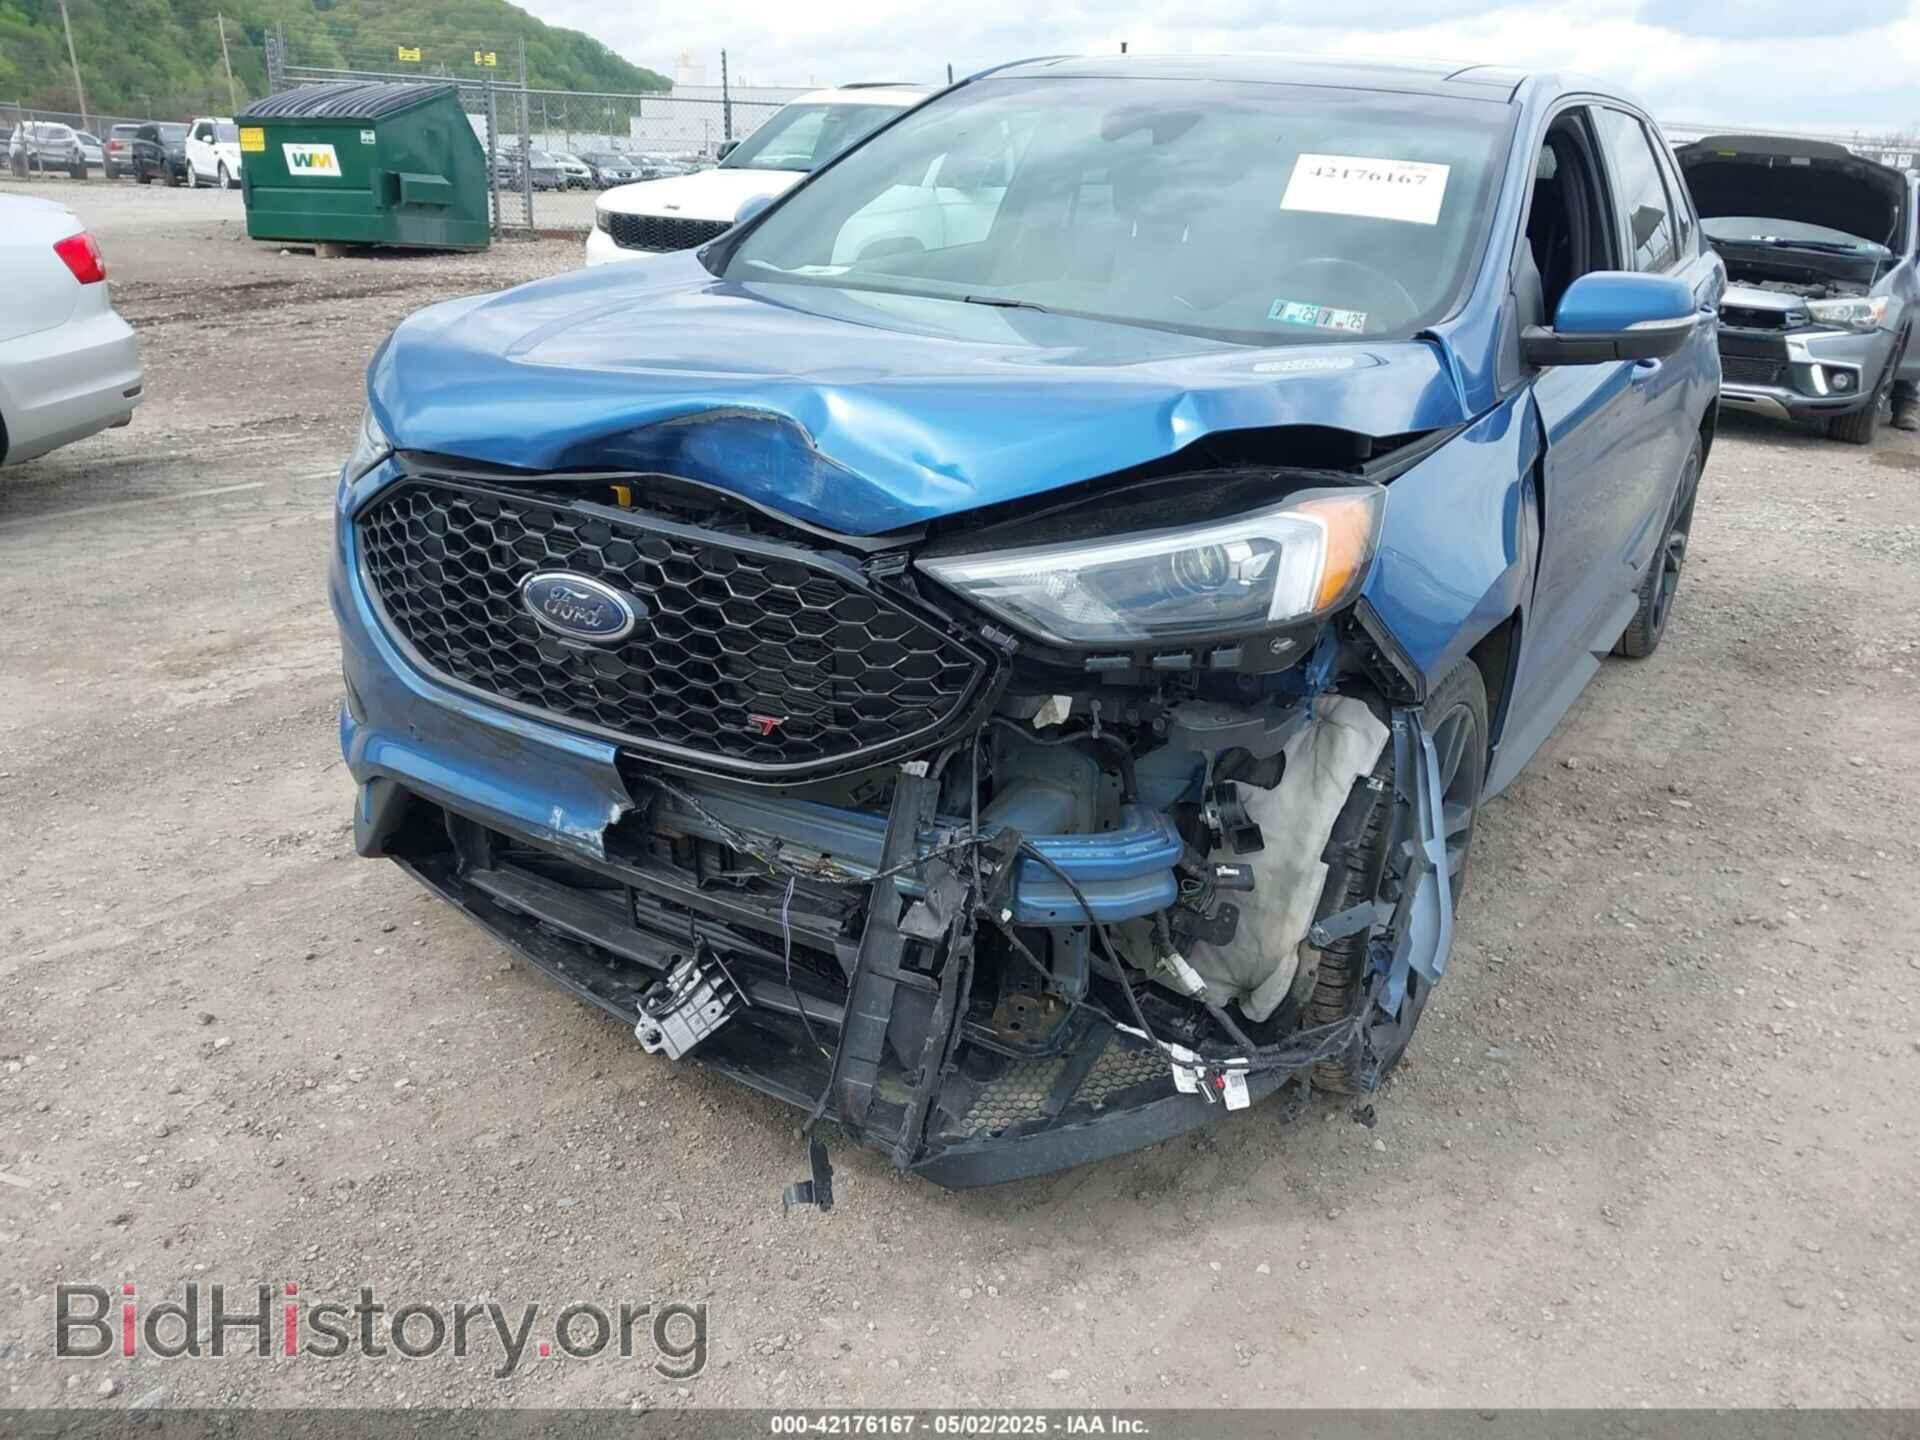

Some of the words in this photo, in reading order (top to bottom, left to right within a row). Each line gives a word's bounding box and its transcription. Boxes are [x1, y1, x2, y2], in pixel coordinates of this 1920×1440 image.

[292, 152, 333, 168] WM
[1308, 166, 1428, 185] 42176167
[544, 585, 604, 627] Ford
